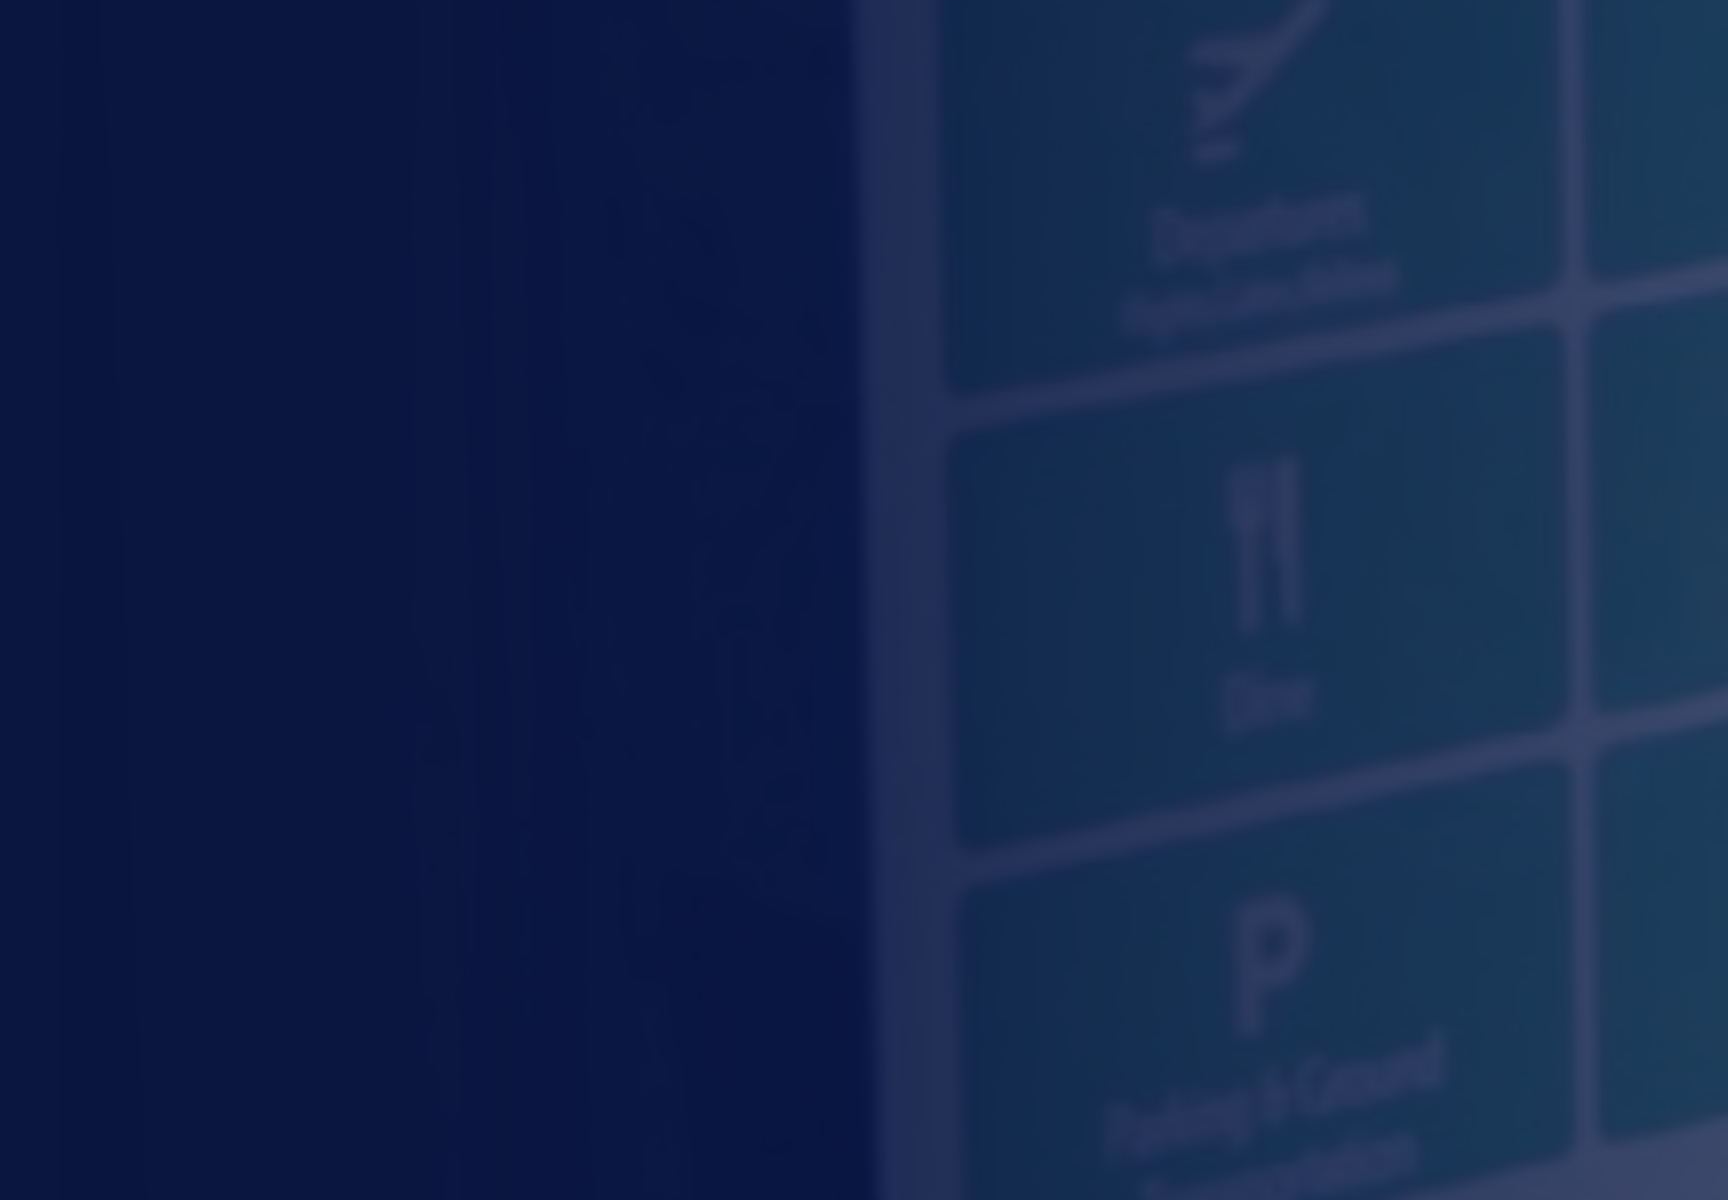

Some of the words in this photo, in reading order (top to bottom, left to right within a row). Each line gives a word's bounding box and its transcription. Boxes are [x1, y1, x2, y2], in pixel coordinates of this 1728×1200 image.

[1146, 190, 1370, 274] Departures
[1217, 664, 1320, 741] Dine
[1232, 896, 1312, 1040] P
[1101, 1088, 1250, 1170] Parking
[1295, 1025, 1446, 1118] Ground
